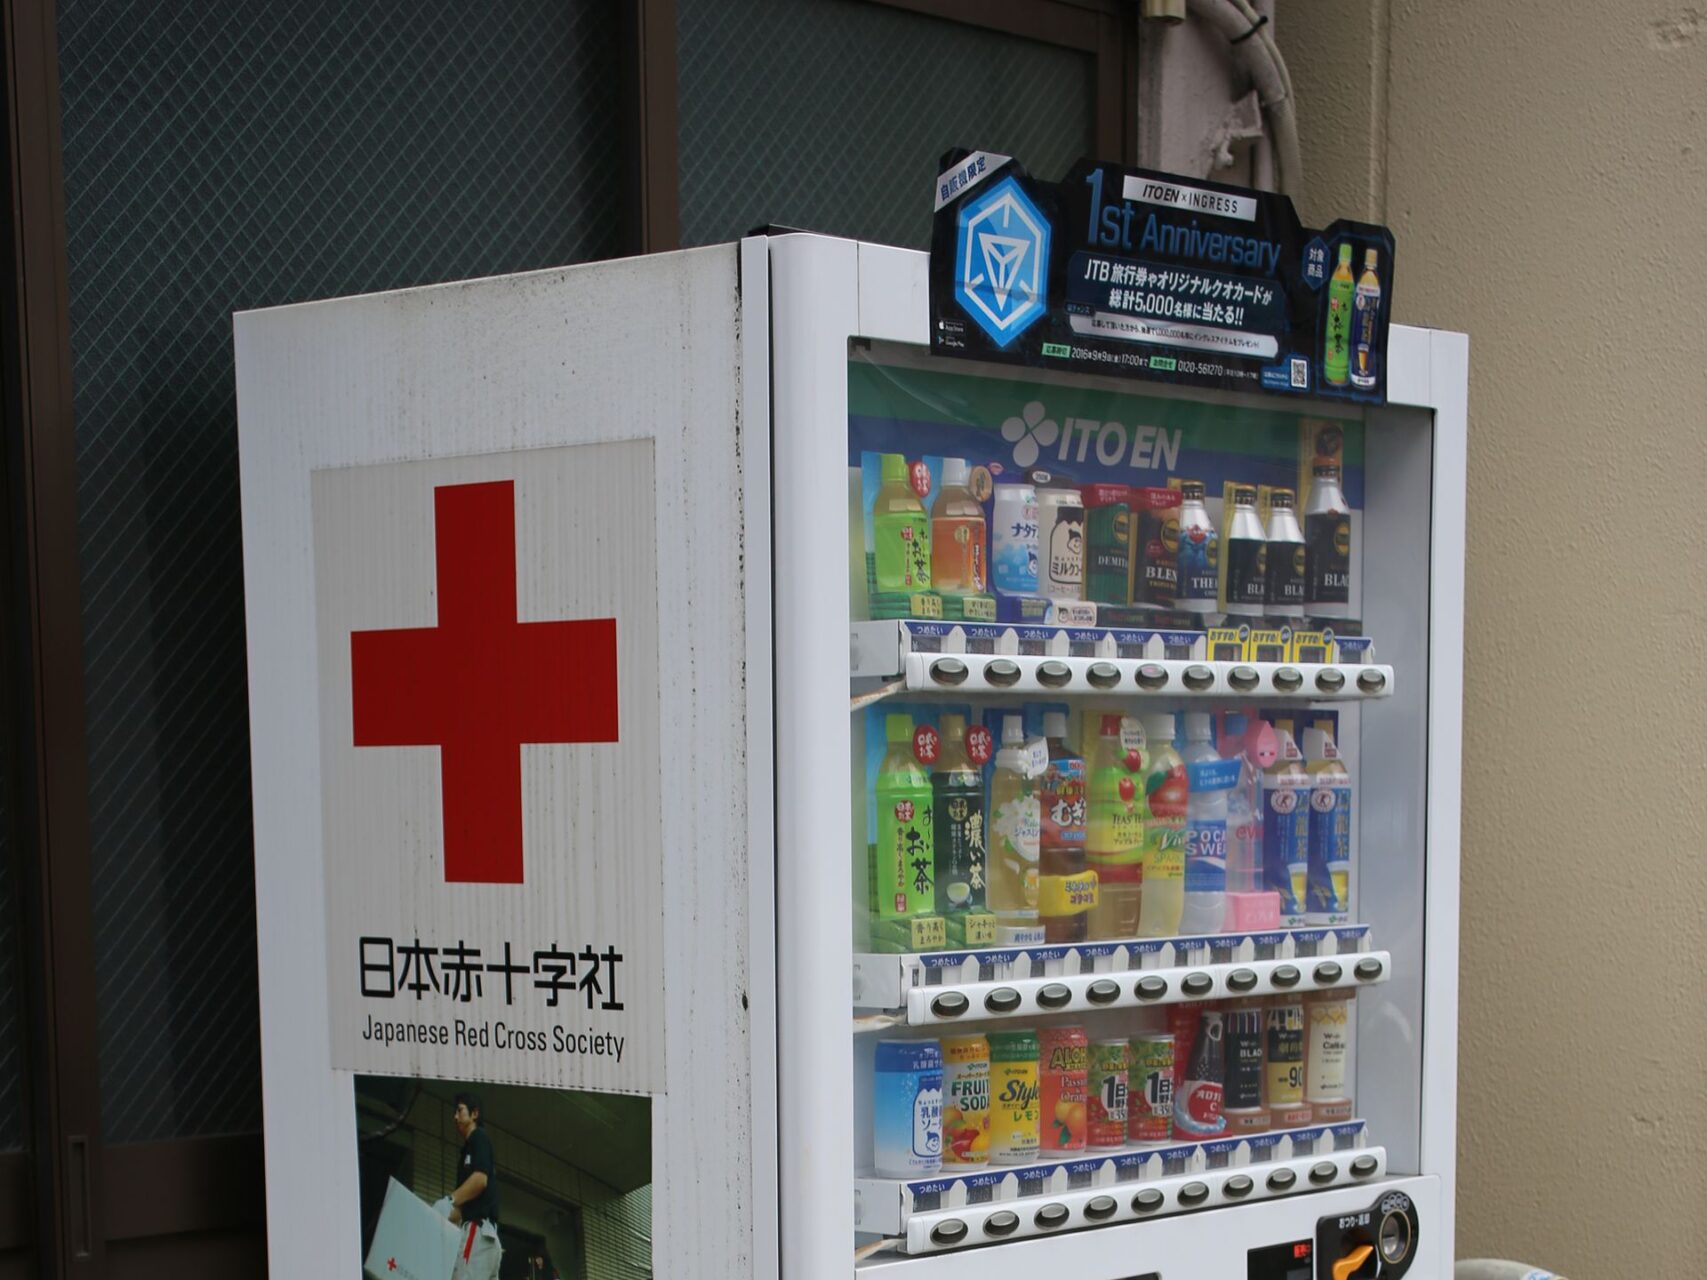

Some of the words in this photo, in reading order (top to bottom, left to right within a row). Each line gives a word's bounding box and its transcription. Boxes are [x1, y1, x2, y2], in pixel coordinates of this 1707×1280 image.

[940, 156, 986, 201] 自販機限定
[1086, 168, 1135, 249] 1st
[1140, 213, 1281, 278] Anniversary
[1189, 192, 1238, 214] INGRESS
[1177, 360, 1223, 377] 0120-561270
[905, 826, 934, 895] お茶
[359, 936, 625, 1011] 日本赤十字社
[362, 1014, 449, 1048] Japanese
[455, 1019, 489, 1048] Red
[494, 1021, 547, 1051] Cross
[552, 1024, 625, 1063] Society
[919, 1184, 945, 1193] つめたい
